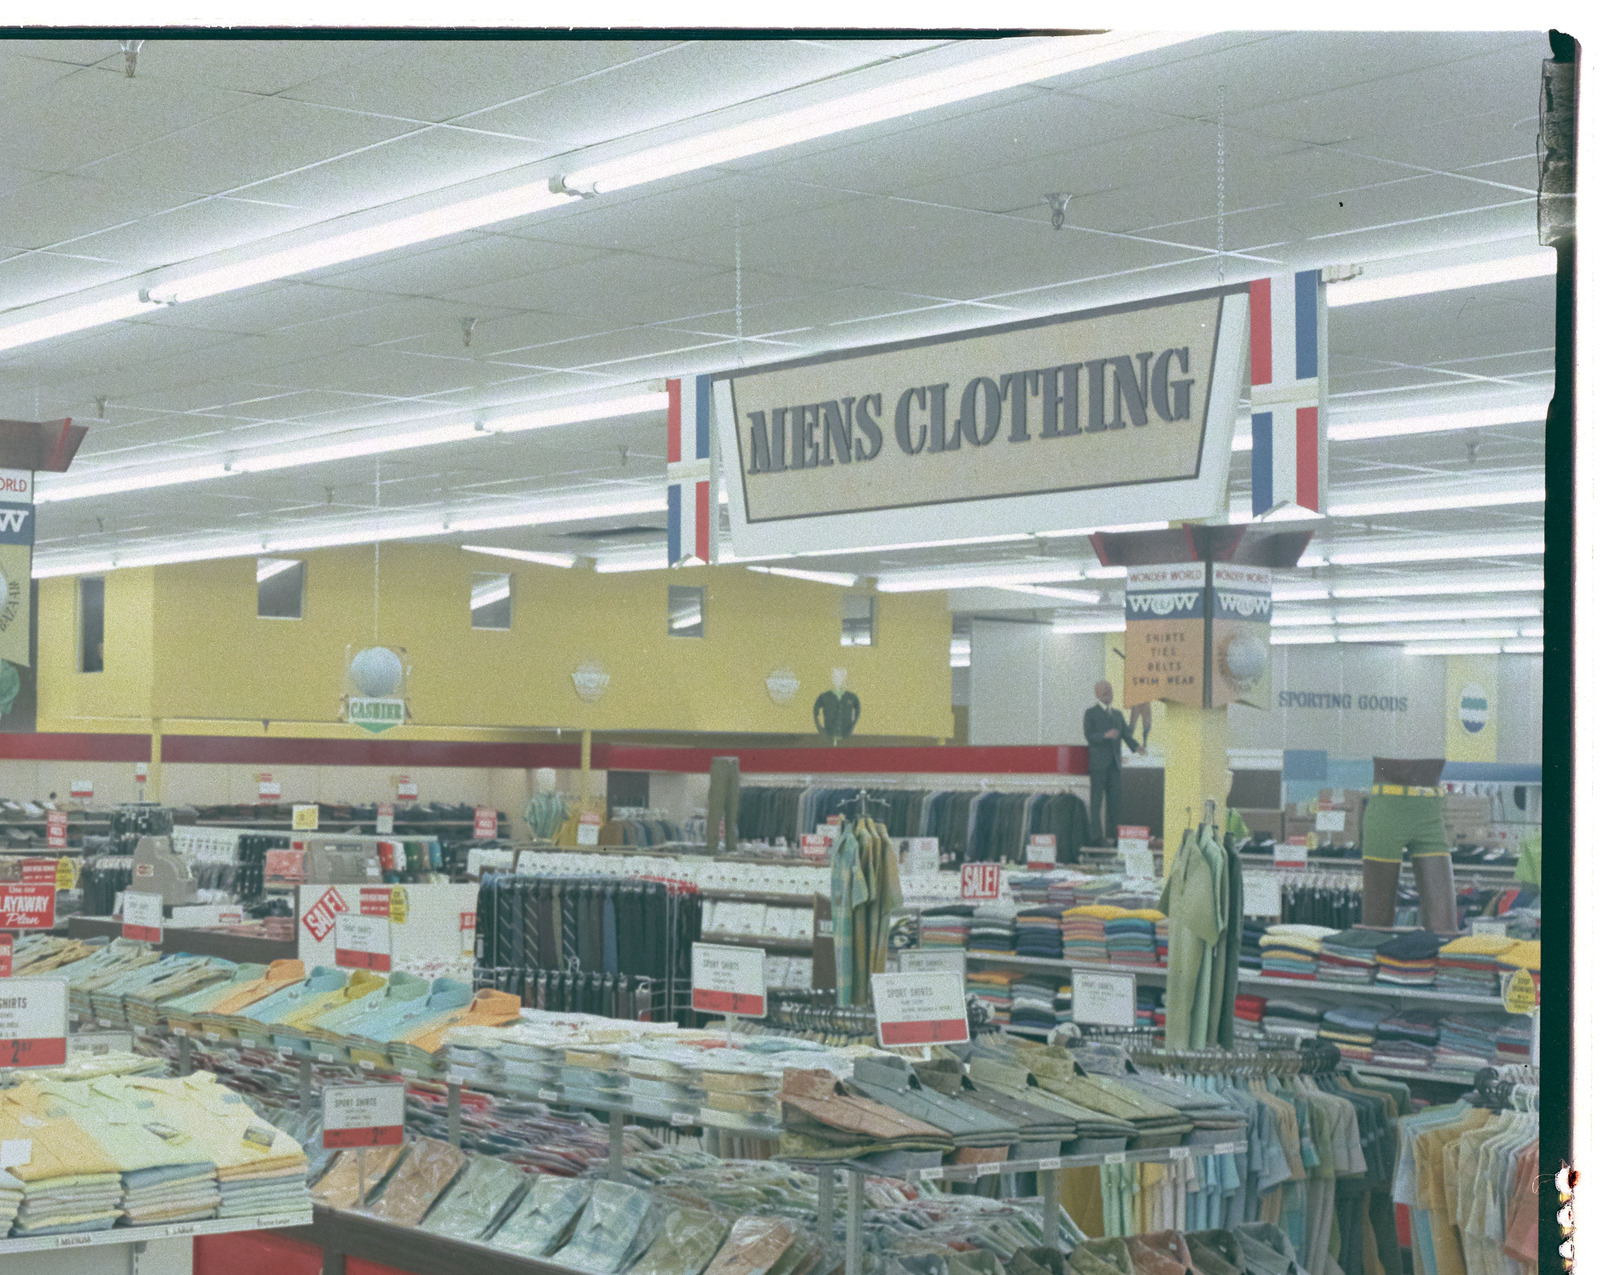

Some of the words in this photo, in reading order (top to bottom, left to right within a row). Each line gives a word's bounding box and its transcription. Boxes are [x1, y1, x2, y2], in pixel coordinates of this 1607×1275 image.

[745, 391, 884, 475] MENS
[895, 346, 1195, 456] CLOTHING
[1130, 572, 1167, 582] WONDER
[1171, 569, 1202, 581] WORLD
[1215, 571, 1244, 582] WONDER
[1145, 632, 1186, 643] SHIRTS
[1132, 677, 1159, 685] SWIM
[1167, 676, 1195, 685] WEAR
[1278, 690, 1352, 709] SPORTING
[1357, 694, 1409, 713] GOODS
[350, 702, 402, 719] CASHIER
[963, 865, 998, 897] SALE!
[5, 912, 40, 927] Plan
